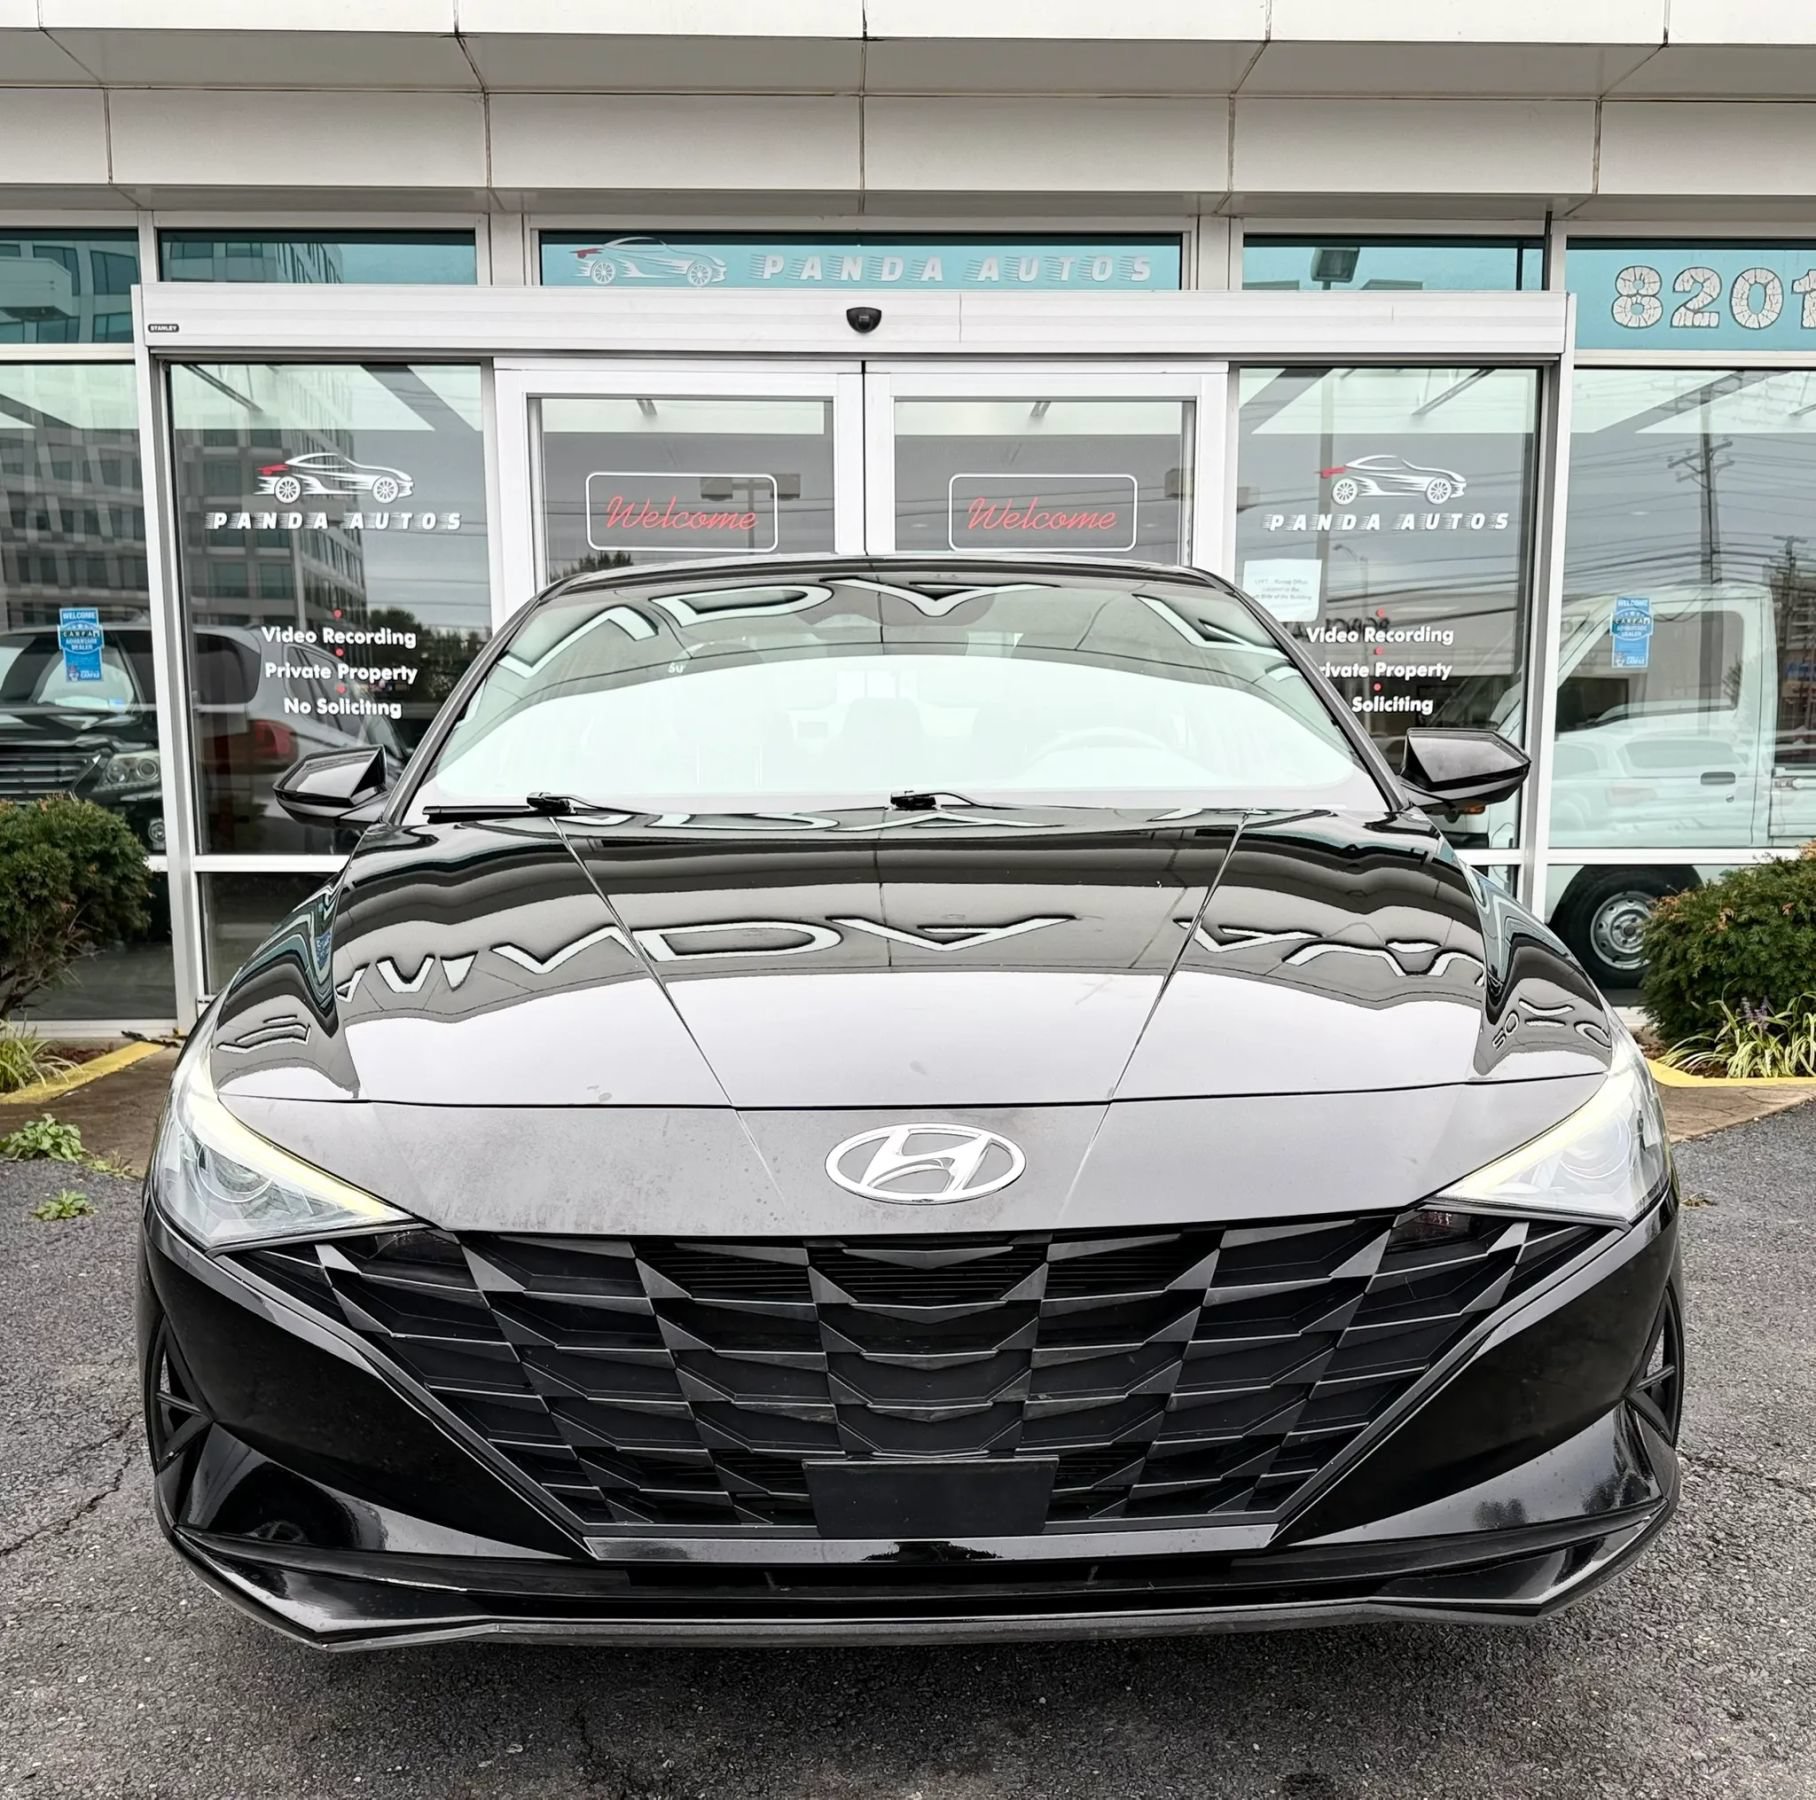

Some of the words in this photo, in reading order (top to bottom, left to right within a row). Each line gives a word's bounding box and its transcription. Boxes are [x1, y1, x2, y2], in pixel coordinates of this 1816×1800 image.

[749, 253, 944, 282] PANDA
[964, 255, 1152, 283] AUTOS
[1611, 265, 1816, 331] 8201
[205, 512, 329, 530] PANDA
[344, 512, 462, 530] AUTOS
[605, 495, 760, 532] Welcome
[966, 495, 1119, 532] Welcome
[1264, 513, 1381, 531] PANDA
[1393, 512, 1510, 530] AUTOS
[261, 626, 317, 644] Video
[323, 627, 417, 648] Recording
[1306, 626, 1360, 643] Video
[1364, 627, 1454, 646] Recording
[265, 662, 332, 679] Private
[337, 663, 418, 684] Property
[1318, 662, 1370, 678] rivate
[1375, 661, 1452, 681] Property
[284, 698, 311, 714] No
[317, 698, 402, 719] Soliciting
[1352, 696, 1434, 715] Soliciting
